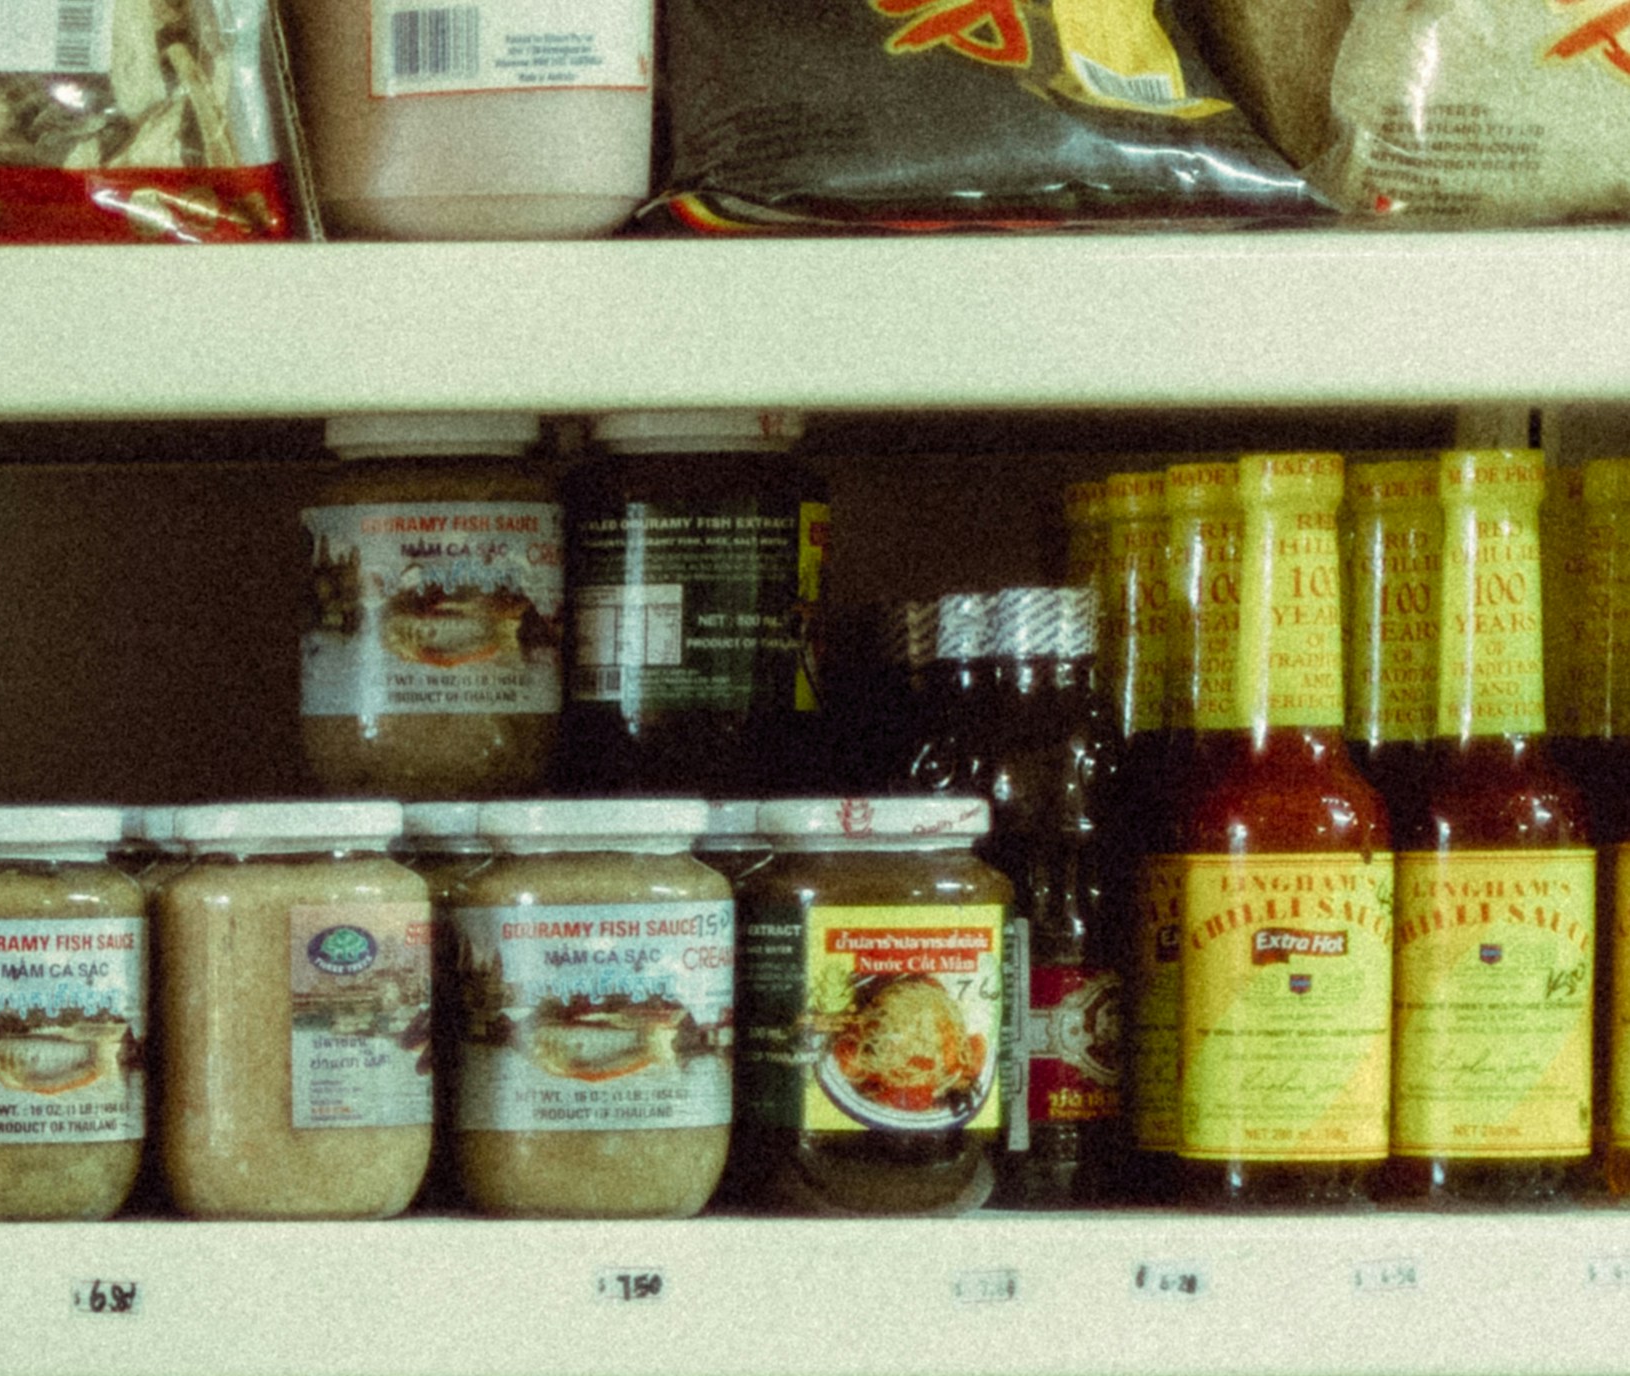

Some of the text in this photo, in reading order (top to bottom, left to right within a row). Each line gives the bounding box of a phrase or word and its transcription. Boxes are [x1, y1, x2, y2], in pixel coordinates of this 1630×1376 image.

[1220, 873, 1377, 893] LINGHAM'S
[503, 919, 698, 940] GOURAMY FISH SAUCE
[1192, 896, 1303, 950] CHILLI
[55, 934, 93, 951] FISH
[96, 933, 136, 950] SAUCE
[1254, 931, 1345, 954] Extra Hot
[49, 1120, 65, 1134] OF
